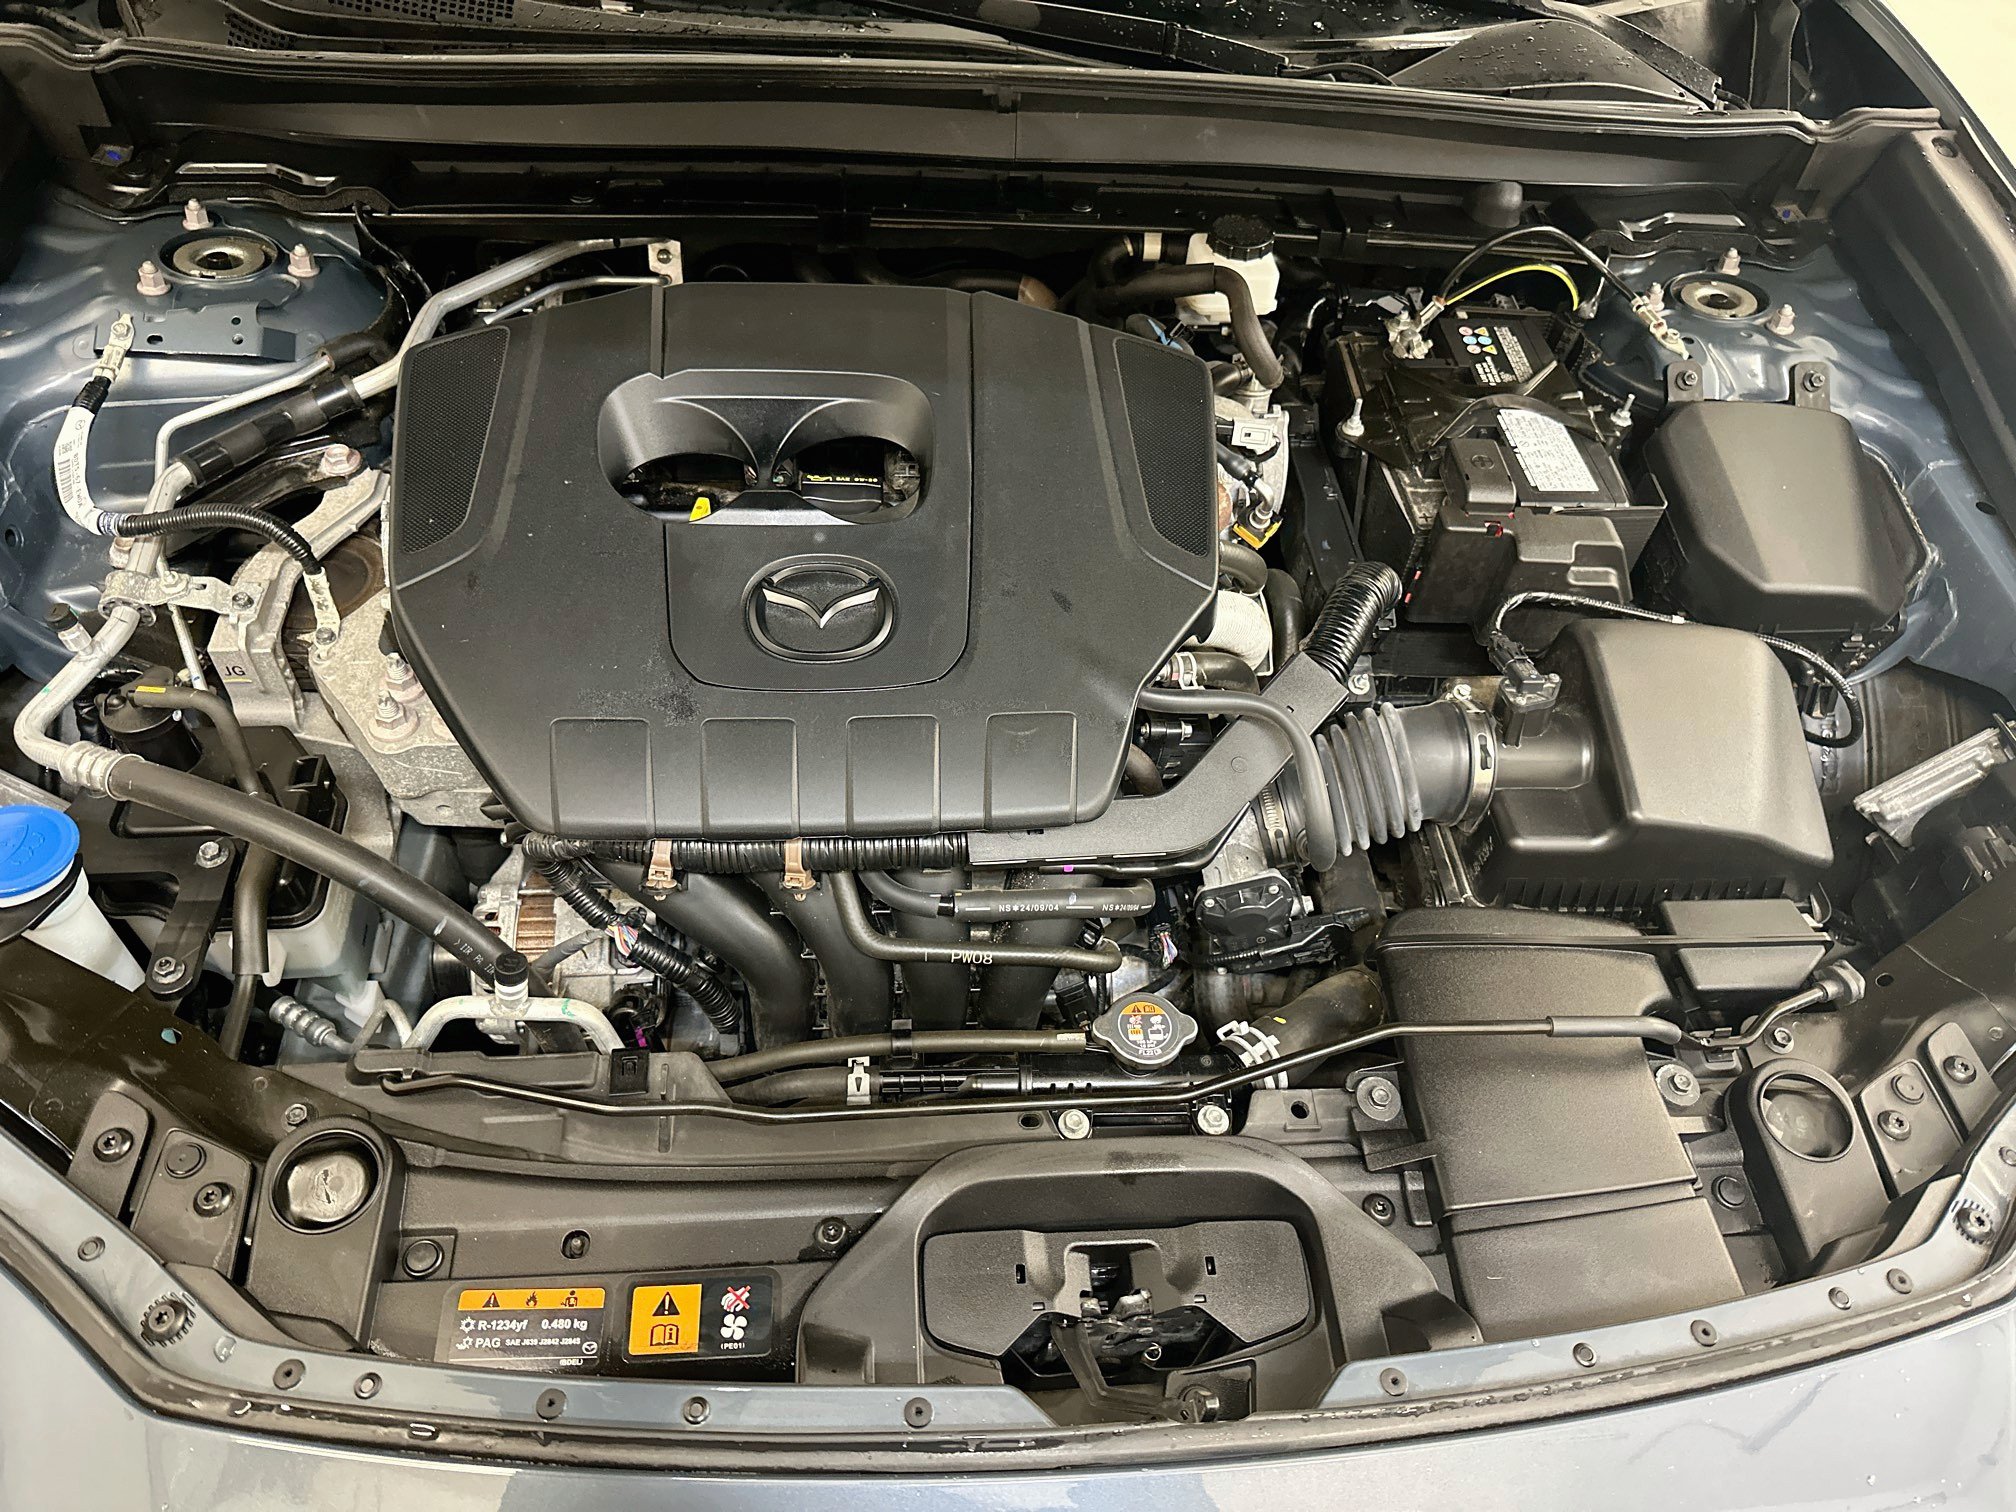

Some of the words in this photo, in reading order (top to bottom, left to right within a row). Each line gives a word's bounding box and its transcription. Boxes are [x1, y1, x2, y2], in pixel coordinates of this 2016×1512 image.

[477, 1319, 529, 1333] R-1234yf
[541, 1318, 572, 1330] 0.480
[573, 1318, 588, 1331] kg
[474, 1337, 501, 1348] PAG
